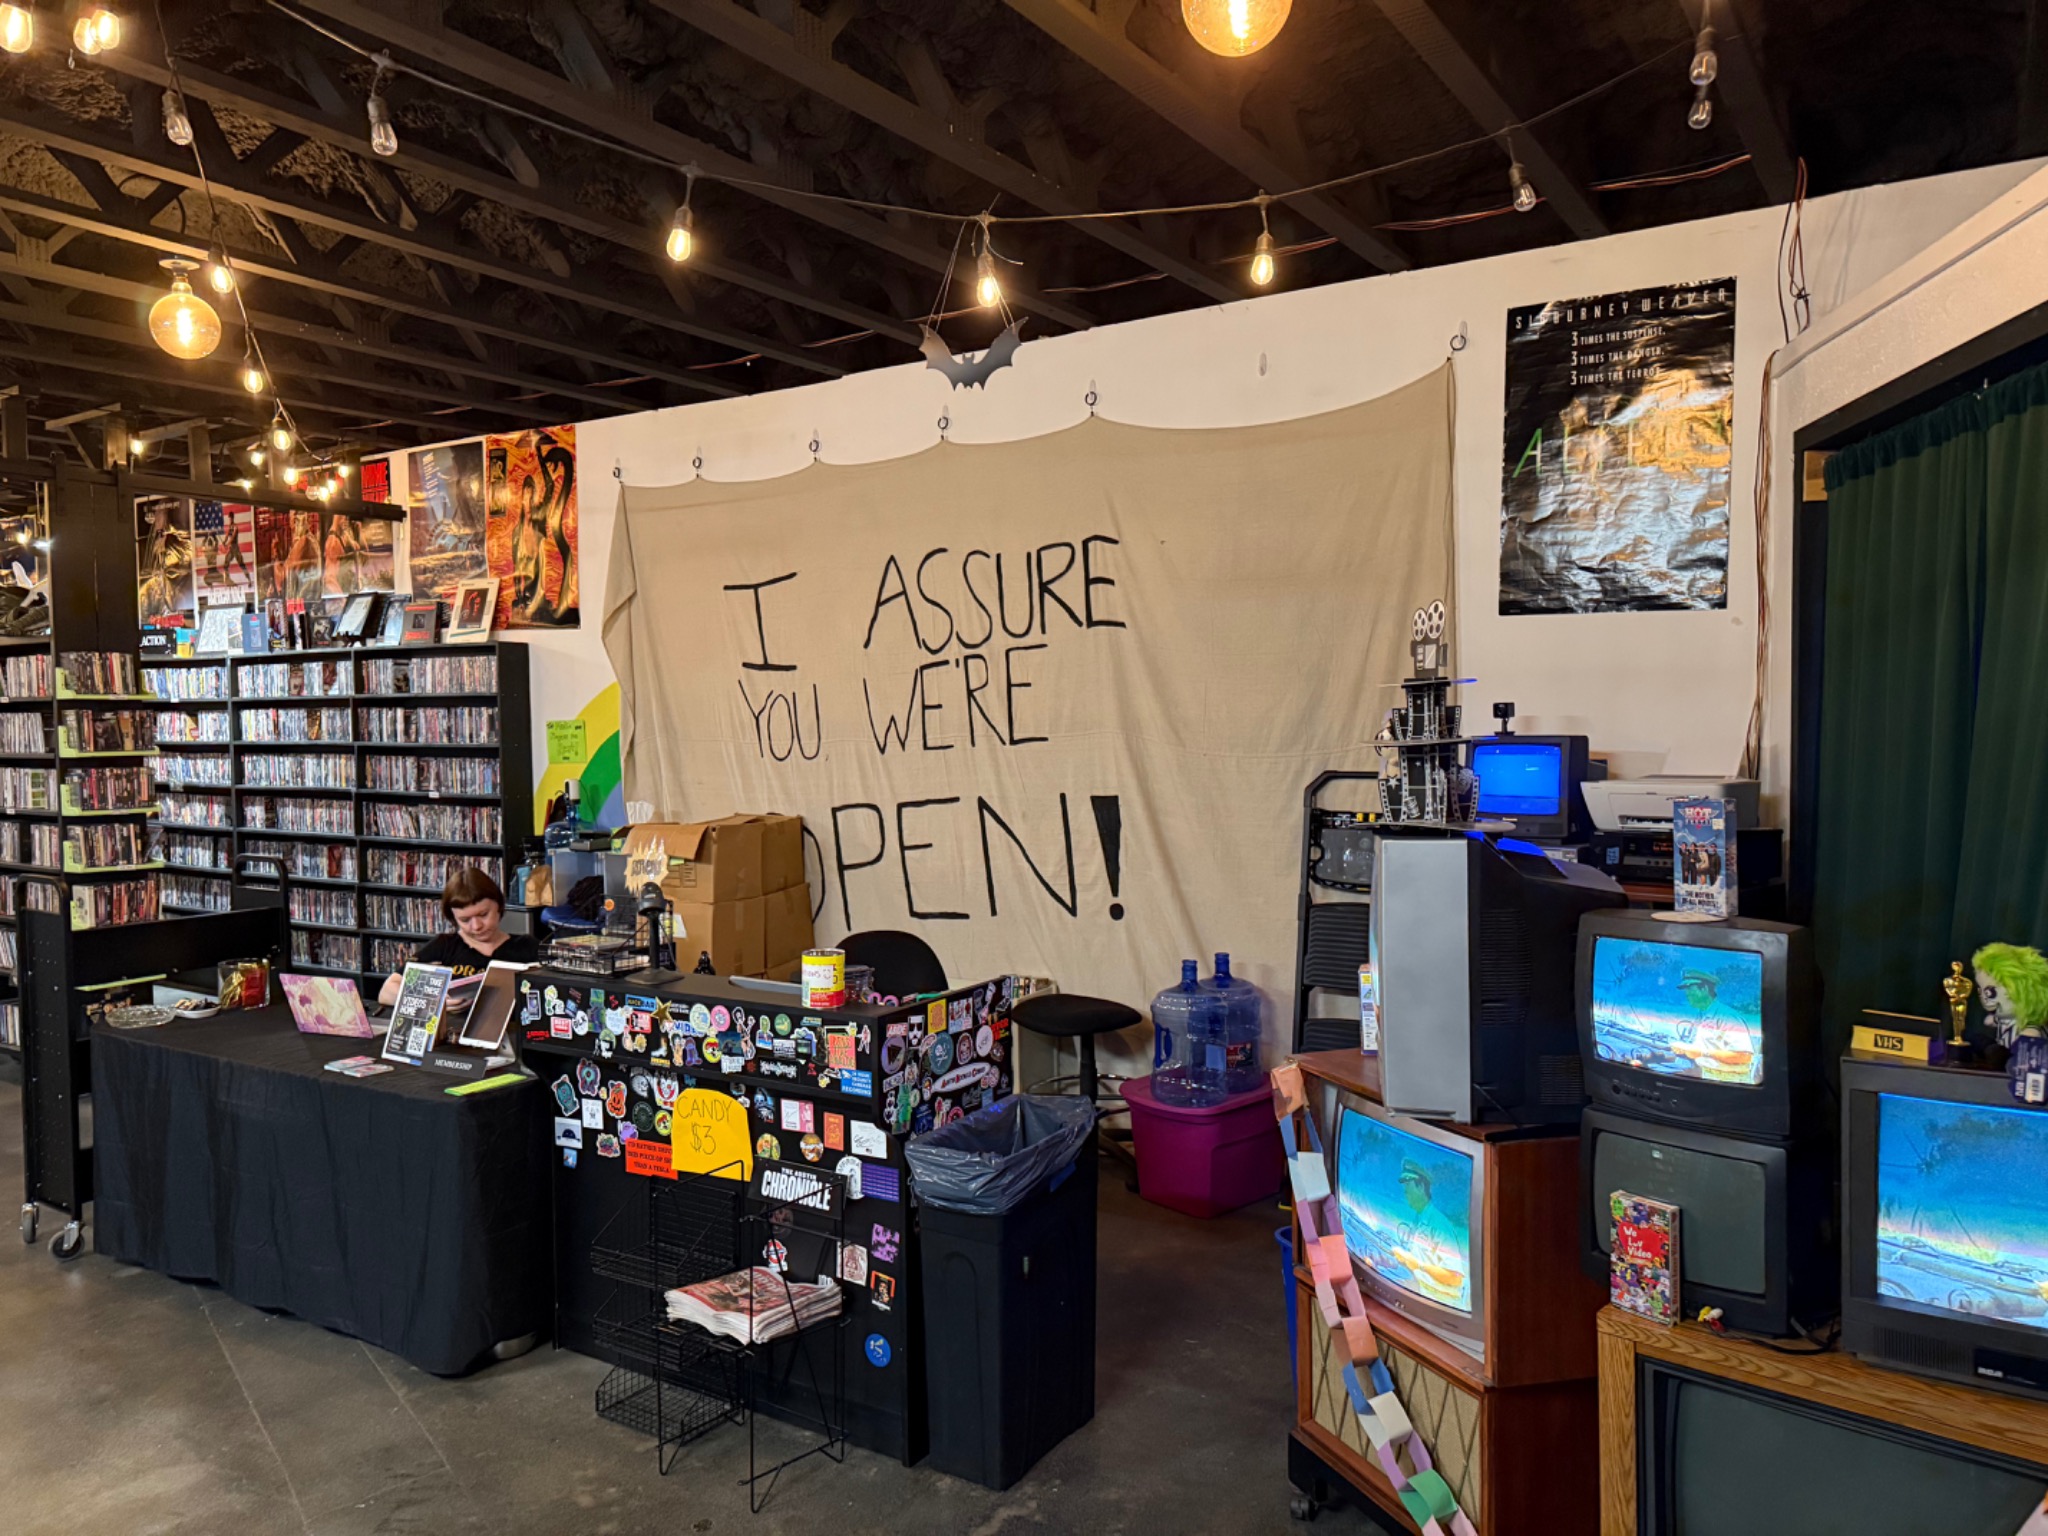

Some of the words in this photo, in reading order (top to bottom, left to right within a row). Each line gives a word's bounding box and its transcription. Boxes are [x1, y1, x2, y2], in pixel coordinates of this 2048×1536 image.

[1641, 287, 1726, 312] WEAVER
[1571, 331, 1578, 347] 3
[1580, 334, 1603, 345] TIMES
[1606, 332, 1620, 343] THE
[1570, 351, 1578, 366] 3
[1579, 353, 1604, 365] TIMES
[1608, 351, 1623, 363] THE
[1570, 370, 1577, 385] 3
[1579, 373, 1604, 385] TIMES
[1608, 371, 1623, 382] THE
[723, 571, 798, 672] I
[863, 534, 1127, 655] ASSURE
[737, 678, 821, 762] YOU
[863, 643, 1049, 755] WE'RE
[402, 996, 427, 1009] VIDEOS
[399, 1006, 418, 1016] HOME
[1876, 1034, 1901, 1050] VHS
[434, 1058, 473, 1071] MEMBERSHIP
[676, 1095, 733, 1124] CANDY
[689, 1121, 717, 1156] $3
[781, 1166, 794, 1176] THE
[794, 1170, 817, 1180] AUSTIN
[761, 1169, 833, 1211] CHRONICLE
[1623, 1225, 1637, 1237] We
[1627, 1246, 1652, 1259] Video
